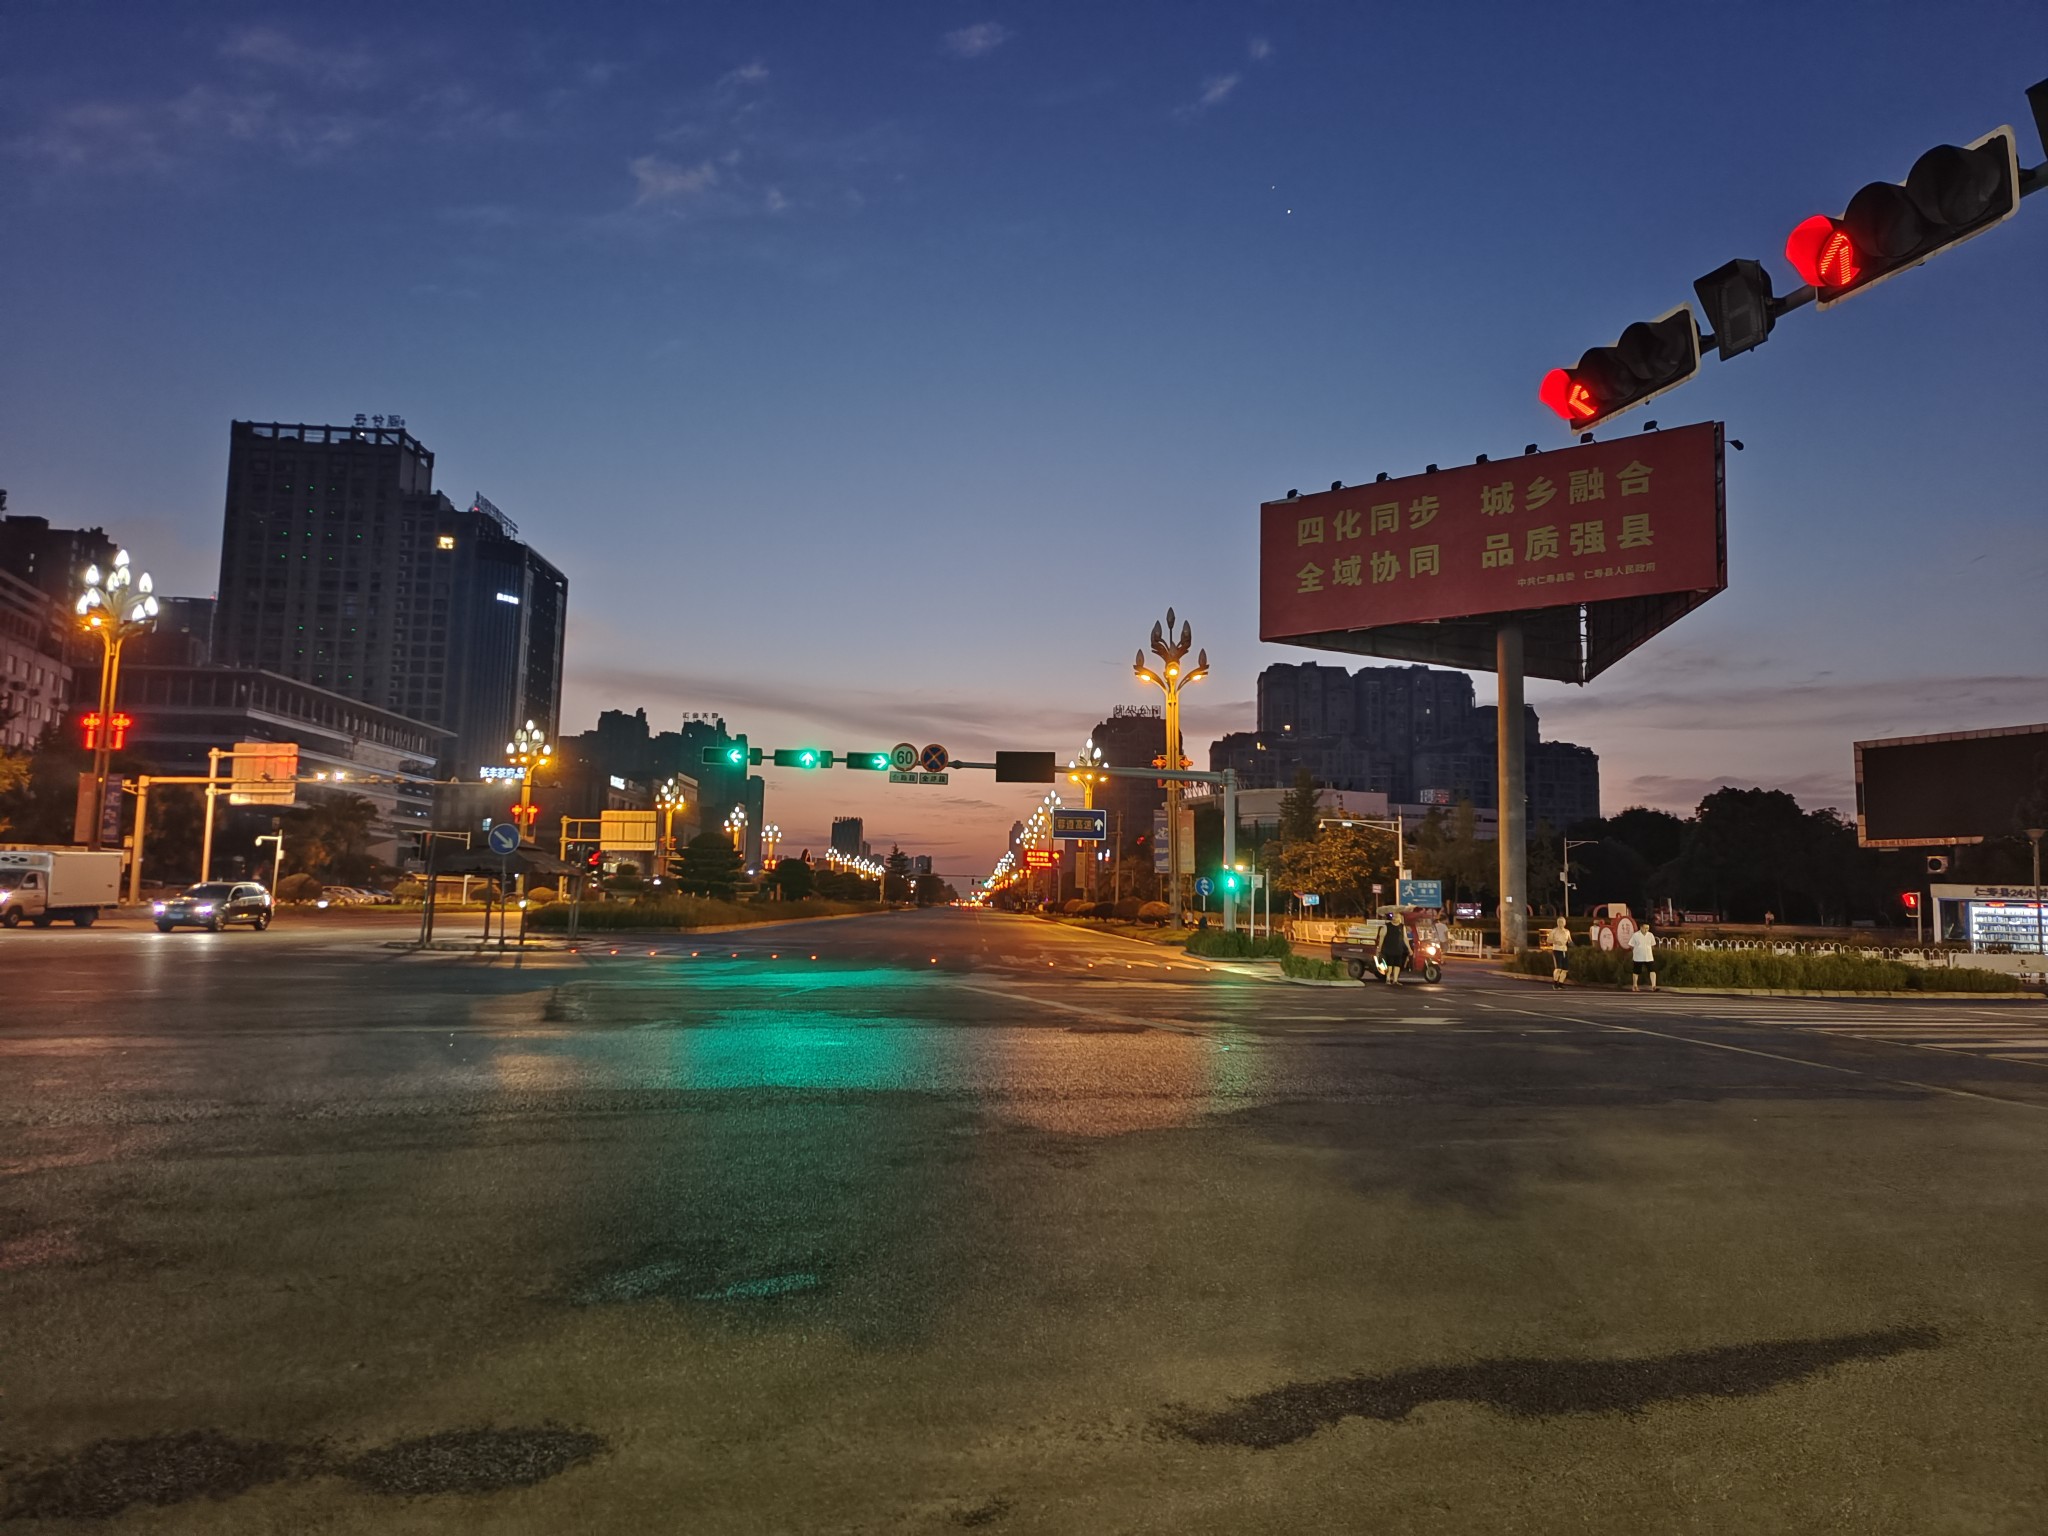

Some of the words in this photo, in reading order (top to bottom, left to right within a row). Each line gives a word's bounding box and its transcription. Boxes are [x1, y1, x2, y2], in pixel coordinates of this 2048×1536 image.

[1295, 496, 1440, 547] 四化同步
[1480, 460, 1654, 517] 城乡融合
[1295, 544, 1441, 594] 全域协同
[1481, 513, 1655, 569] 品质强县
[1517, 571, 1576, 587] 中共仁寿县委
[1584, 562, 1656, 579] 仁寿县人民政府
[896, 750, 914, 765] 60
